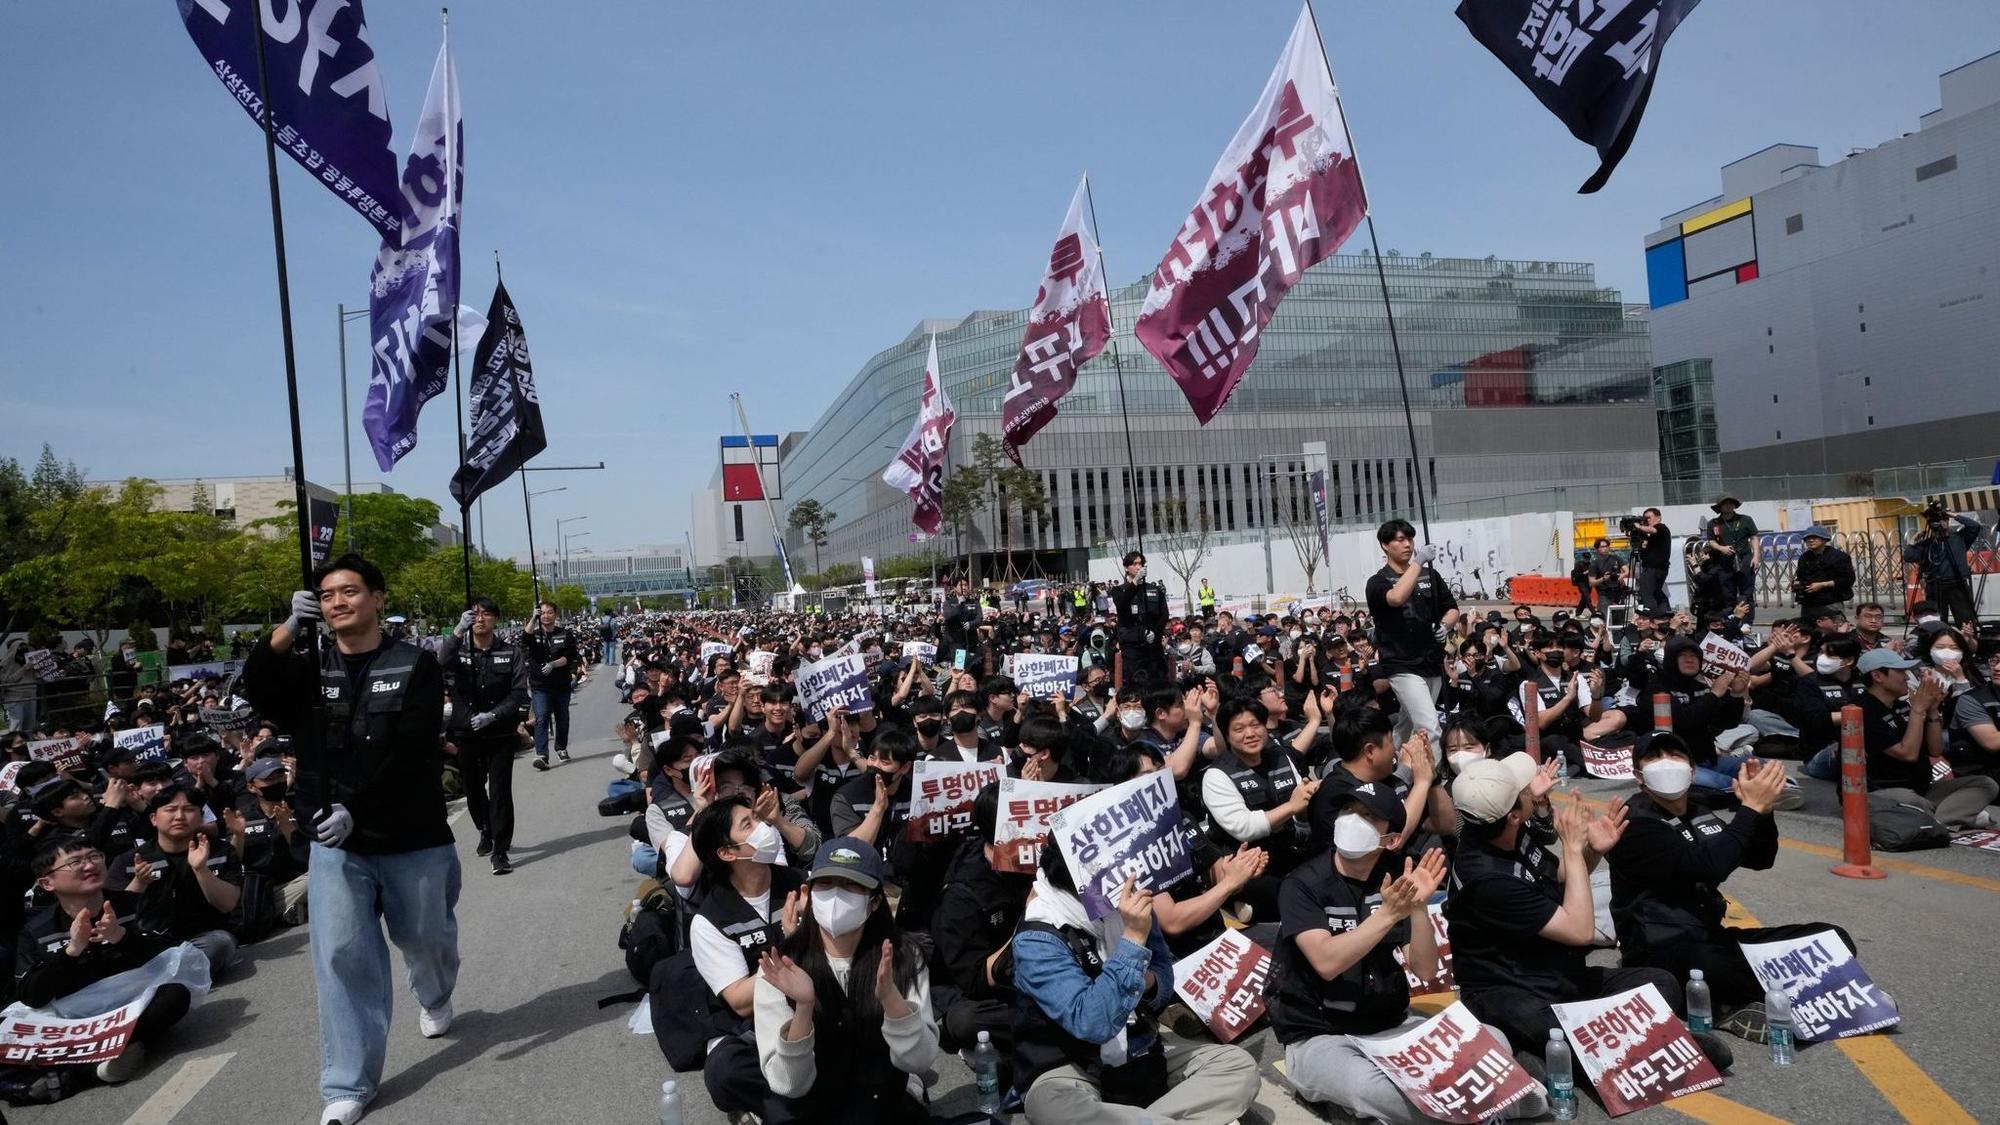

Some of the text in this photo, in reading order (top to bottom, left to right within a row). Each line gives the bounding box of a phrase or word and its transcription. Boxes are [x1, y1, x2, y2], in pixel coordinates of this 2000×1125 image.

[322, 163, 401, 232] 공동투쟁본부
[800, 659, 855, 698] 상한폐지
[1018, 656, 1069, 677] 상한폐지
[372, 681, 400, 692] SELU
[811, 683, 869, 723] 실현하자
[1022, 680, 1076, 699] 실현하자
[34, 740, 73, 759] 투명하게
[921, 767, 1000, 804] 투명하게
[1070, 776, 1169, 864] 상한폐지
[1186, 827, 1198, 839] LU
[1699, 824, 1723, 836] SELU
[1101, 823, 1188, 909] 실현하자
[740, 930, 768, 949] 투쟁
[1182, 938, 1241, 1002] 투명하게
[1219, 954, 1272, 1027] 바꾸고!!!
[1792, 979, 1879, 1039] 실현하자
[8, 1008, 128, 1040] 투명하게
[1572, 992, 1657, 1059] 투명하게
[5, 1033, 127, 1063] 바꾸고!!!
[1418, 1048, 1515, 1116] 바꾸고!!!
[1612, 1036, 1704, 1101] 바꾸고!!!
